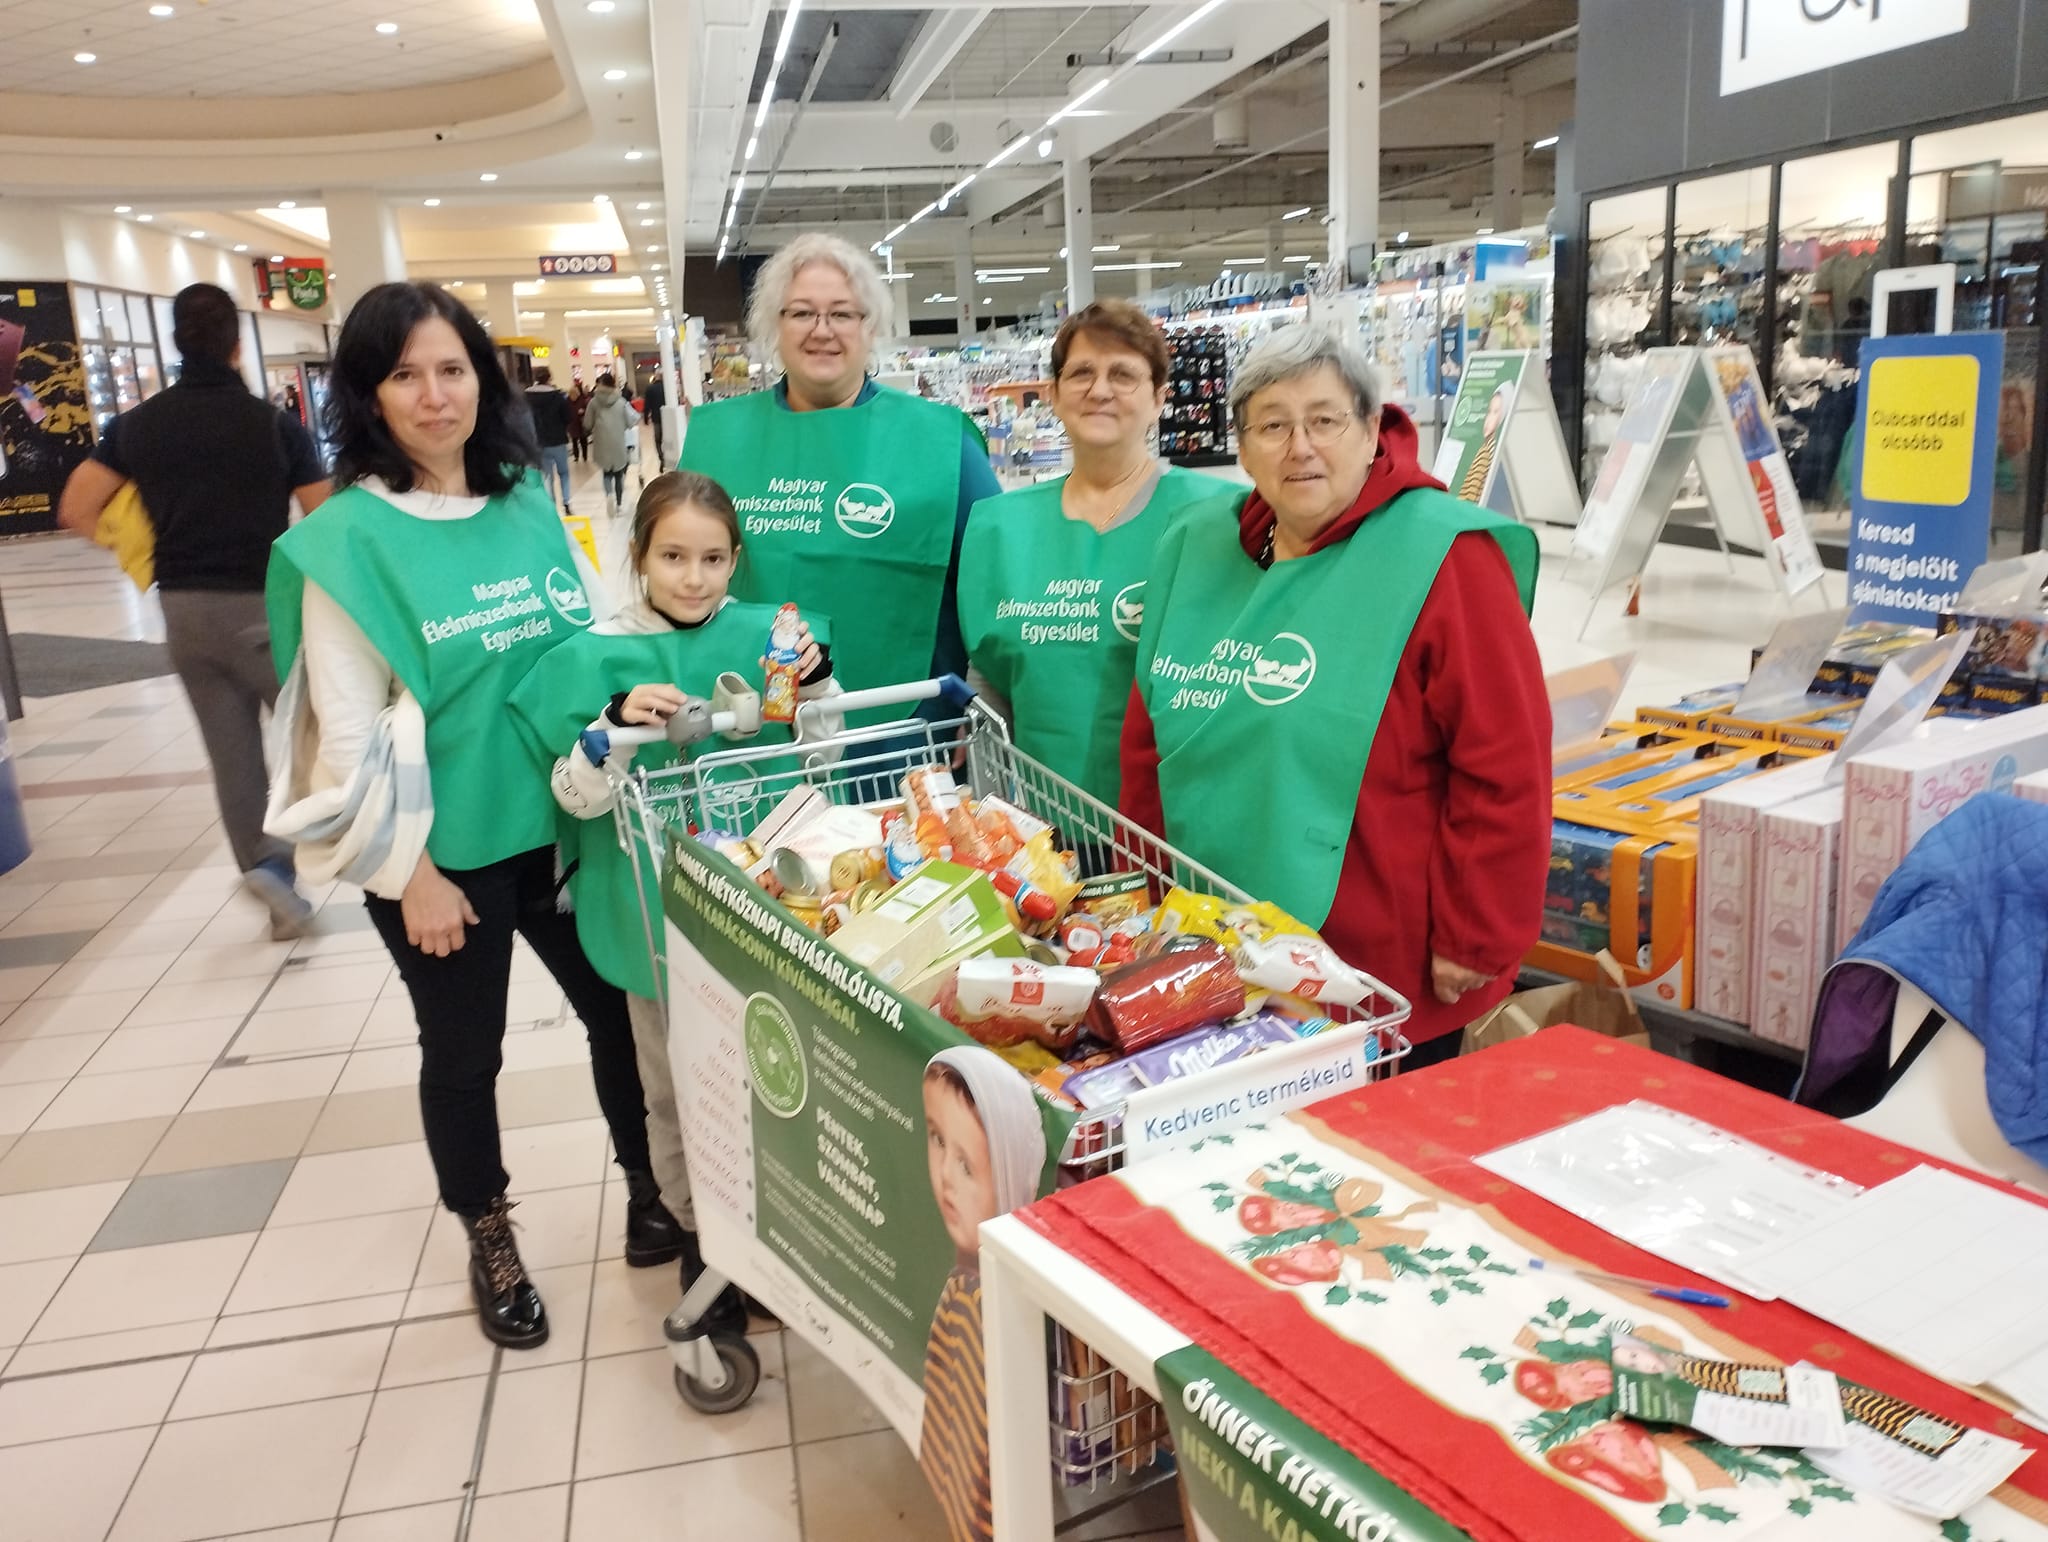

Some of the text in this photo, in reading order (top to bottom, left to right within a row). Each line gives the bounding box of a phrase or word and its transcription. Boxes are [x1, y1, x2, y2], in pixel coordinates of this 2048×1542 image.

[1871, 409, 1966, 428] Clubcarddal
[1881, 434, 1943, 451] olcsóbb
[768, 477, 828, 496] Magyar
[1857, 517, 1916, 546] Keresd
[472, 574, 533, 602] Magyar
[1044, 578, 1104, 599] Magyar
[1854, 552, 1959, 582] a megjelölt
[421, 592, 547, 645] Élelmiszerbank
[707, 872, 783, 942] HÉTKÖZNAPI
[780, 925, 905, 1032] BEVÁSÁRLÓLISTA.
[1144, 1056, 1353, 1142] Kedvenc termékeid
[816, 1105, 869, 1168] PÉNTEK,
[817, 1134, 880, 1203] SZOMBAT,
[817, 1160, 885, 1228] VASÁRNAP
[1182, 1378, 1287, 1474] ÖNNEK
[1181, 1427, 1236, 1499] NEKI
[1239, 1481, 1258, 1521] A
